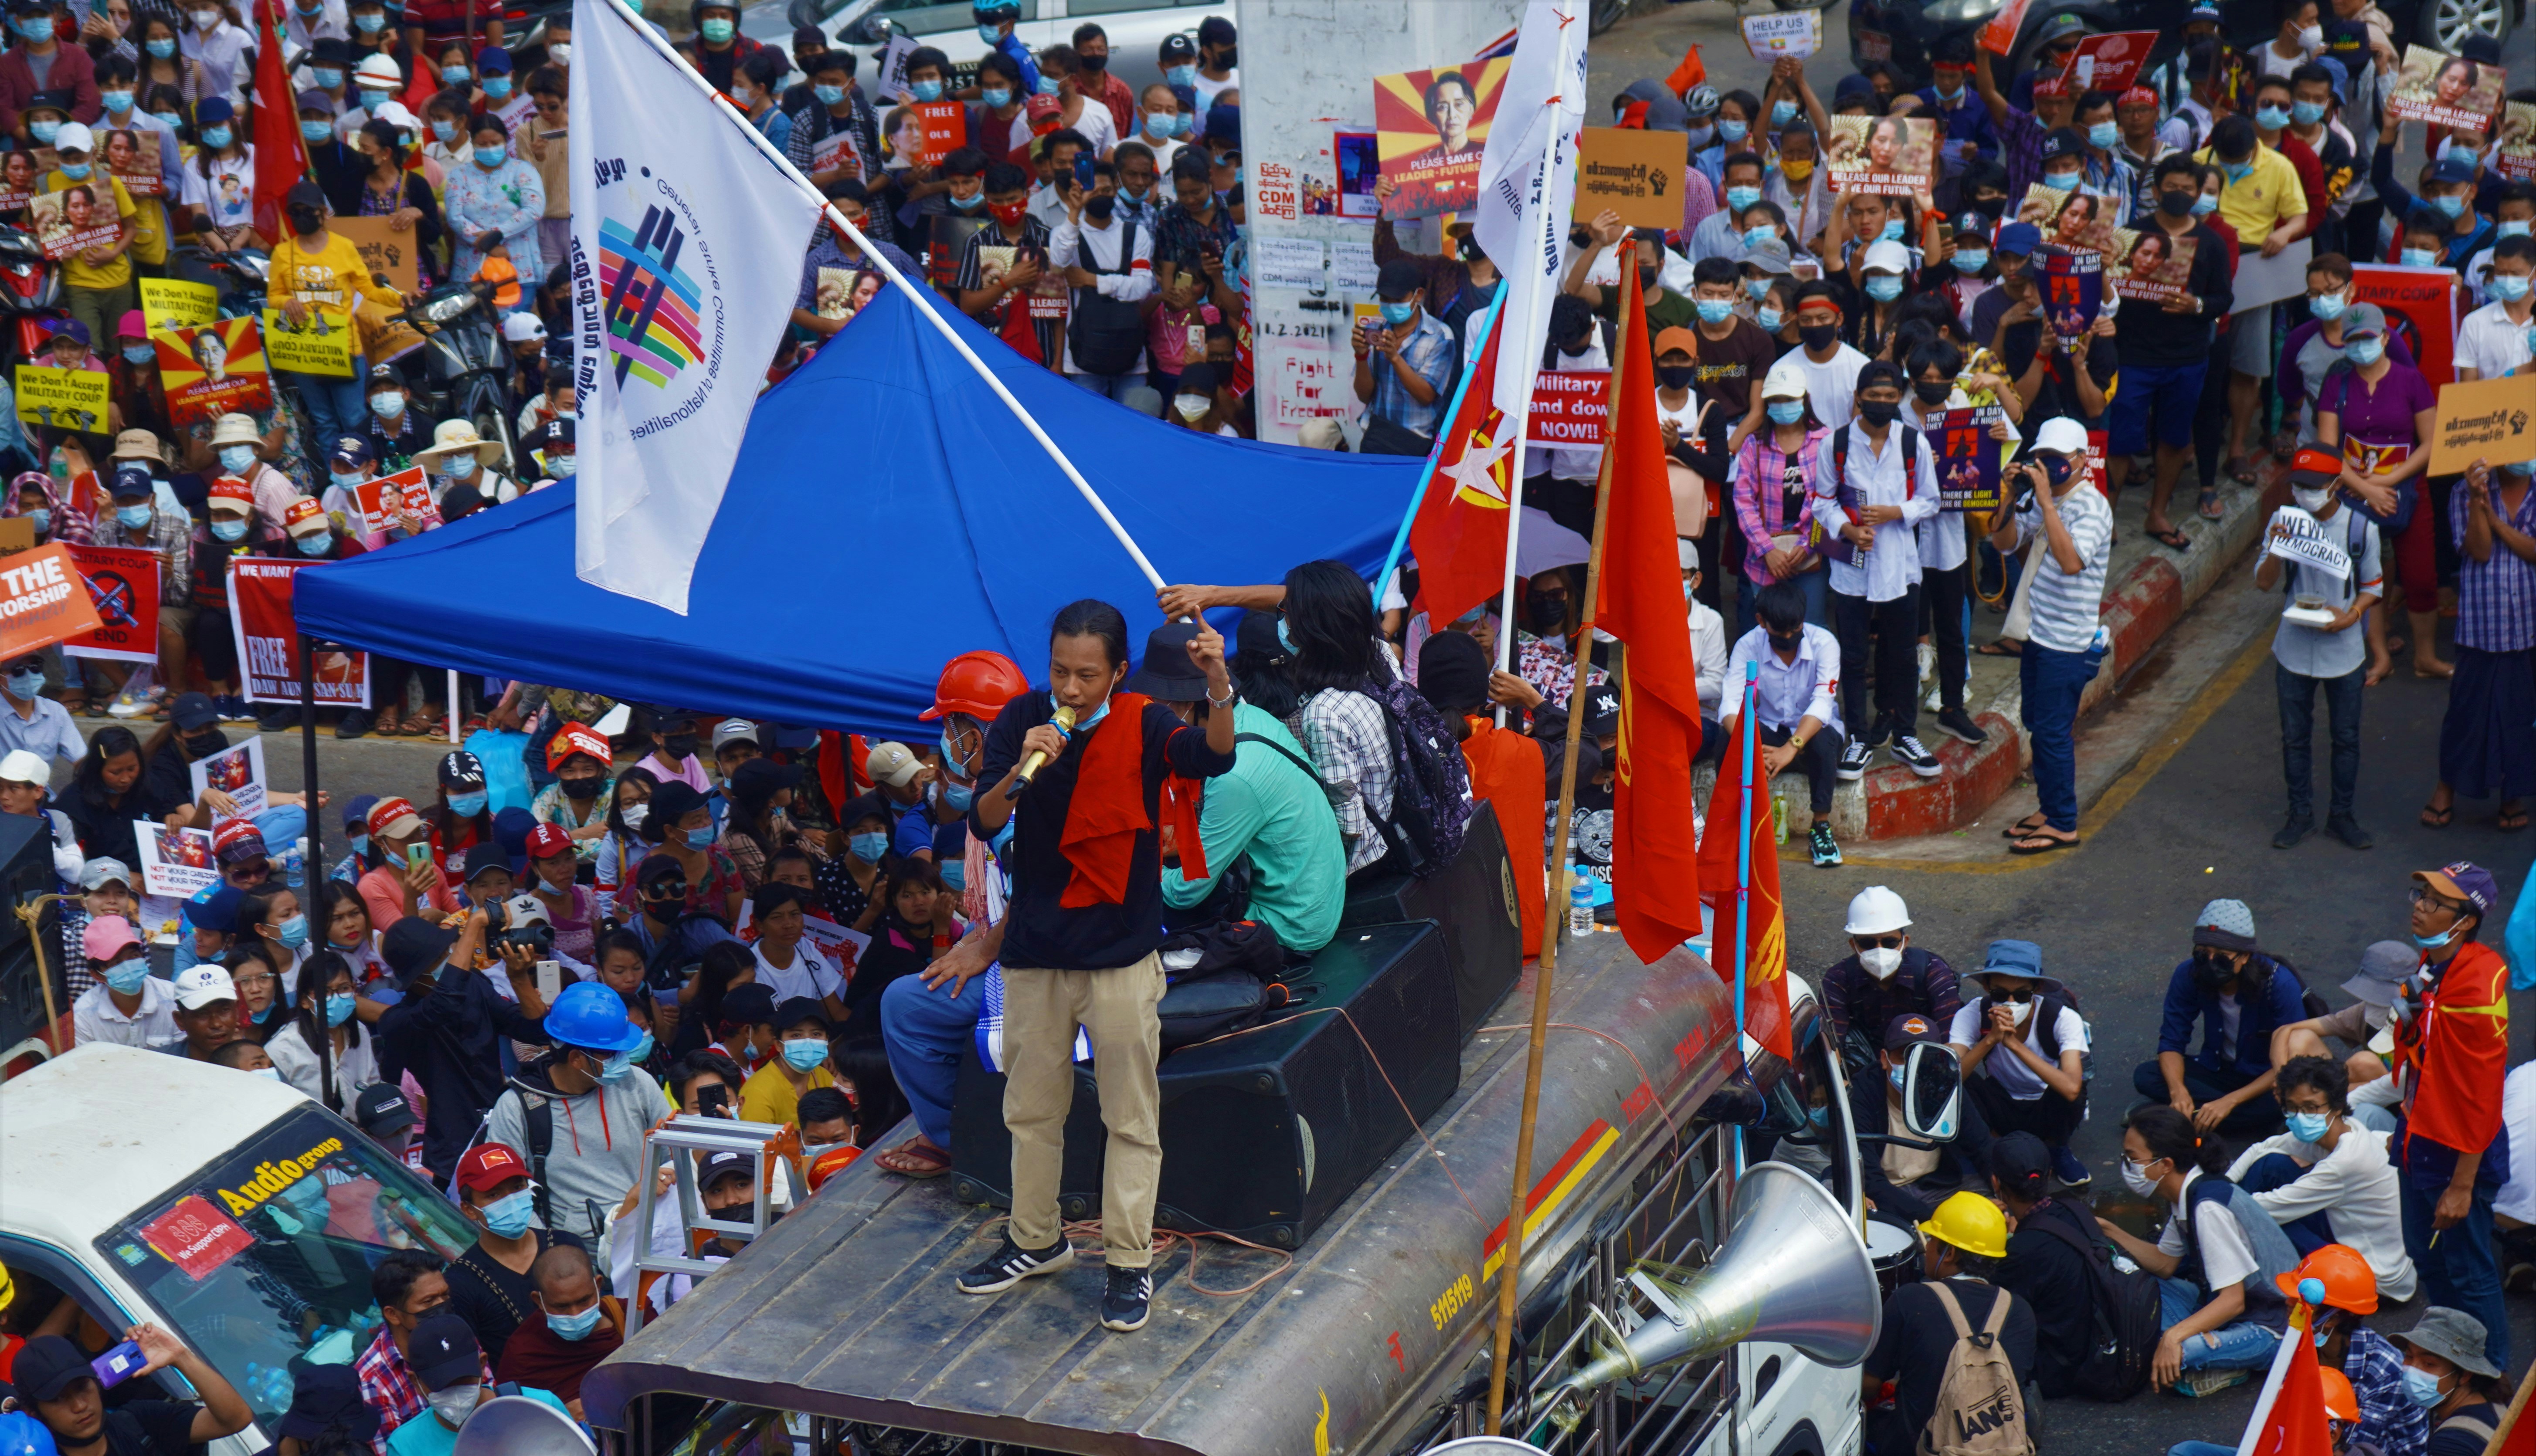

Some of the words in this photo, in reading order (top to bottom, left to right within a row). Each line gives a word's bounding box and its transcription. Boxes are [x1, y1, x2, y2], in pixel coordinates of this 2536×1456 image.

[1752, 20, 1782, 31] HELP
[1787, 17, 1803, 27] US
[925, 107, 955, 118] FREE
[2394, 97, 2433, 112] RELEASE
[2434, 106, 2452, 116] OUR
[2453, 109, 2487, 123] LEADER
[2400, 109, 2423, 119] SAVE
[2423, 112, 2442, 123] OUR
[2442, 116, 2476, 130] FUTURE
[929, 130, 951, 139] OUR
[1411, 156, 1444, 170] PLEASE
[1446, 152, 1473, 165] SAVE
[129, 176, 158, 184] LEADER
[1394, 168, 1435, 183] LEADER
[1440, 162, 1480, 176] FUTURE
[1832, 172, 1870, 183] RELEASE
[1871, 174, 1889, 183] OUR
[1891, 175, 1926, 186] LEADER
[1259, 191, 1294, 203] CDM
[1839, 183, 1862, 193] SVE
[1863, 184, 1881, 194] OUR
[1883, 184, 1915, 195] FUTUR
[45, 234, 75, 250] RELEASE
[75, 230, 92, 241] OUR
[91, 223, 119, 237] LEADER
[71, 241, 87, 251] OUR
[87, 234, 115, 247] FUTURE
[2032, 250, 2047, 262] THEY
[2074, 255, 2082, 266] IN
[2085, 253, 2101, 264] DAY
[2033, 261, 2045, 271] THEY
[2070, 265, 2079, 274] AT
[2080, 262, 2101, 273] NIGHT
[2129, 279, 2146, 289] OUR
[146, 288, 161, 297] We
[163, 288, 187, 298] Don't
[190, 293, 214, 305] Accept
[2119, 288, 2136, 298] OUR
[2400, 288, 2440, 300] COUP
[149, 300, 191, 312] MILITARY
[193, 305, 213, 316] COUP
[1036, 298, 1068, 307] LEADER
[1029, 308, 1060, 317] FUTURE
[272, 340, 297, 349] COUP
[300, 344, 343, 356] MILITARY
[272, 352, 301, 363] Accept
[332, 356, 347, 368] We
[1287, 357, 1335, 378] Fight
[21, 374, 37, 383] We
[71, 379, 105, 392] Accept
[187, 386, 210, 396] PLEASE
[211, 381, 231, 391] SAVE
[1296, 381, 1323, 399] For
[23, 386, 70, 399] MILITARY
[73, 392, 102, 403] COUP
[176, 393, 205, 405] LEADER
[206, 389, 237, 399] FUTURE
[240, 383, 260, 391] HOPE
[1282, 400, 1345, 417] Freedom
[1572, 400, 1608, 416] dow
[1926, 412, 1947, 423] THEY
[1976, 407, 1986, 417] IN
[1987, 406, 2003, 416] DAY
[548, 421, 562, 437] H
[1541, 421, 1599, 439] NOW!!
[1925, 421, 1943, 431] THEY
[1970, 417, 1979, 426] AT
[1981, 415, 2002, 425] NIGHT
[1943, 490, 1962, 499] THERE
[1964, 490, 1972, 499] BE
[1974, 489, 1993, 498] LIGHT
[299, 498, 317, 511] NLD
[1954, 499, 1962, 508] BE
[1963, 498, 2000, 508] DEMOCRACY
[366, 510, 383, 521] FREE
[118, 557, 149, 569] COUP
[0, 555, 65, 596] THE
[240, 565, 258, 576] WE
[260, 565, 291, 578] WANT
[94, 630, 128, 643] END
[246, 635, 289, 677] FREE
[251, 678, 278, 694] DAW
[281, 681, 302, 696] AUN
[150, 865, 165, 873] NOT
[167, 867, 188, 877] YOUR
[150, 874, 165, 882] NOT
[167, 876, 188, 885] YOUR
[1504, 872, 1514, 912] Protech
[816, 928, 843, 941] MOVEMENT
[1674, 1024, 1706, 1070] THAN
[217, 1159, 304, 1216] Audio
[296, 1137, 343, 1170] group
[177, 1247, 194, 1260] We
[189, 1230, 218, 1255] Support
[210, 1222, 231, 1241] CRPH
[1430, 1273, 1473, 1331] 5115119
[1953, 1385, 2016, 1443] VANS
